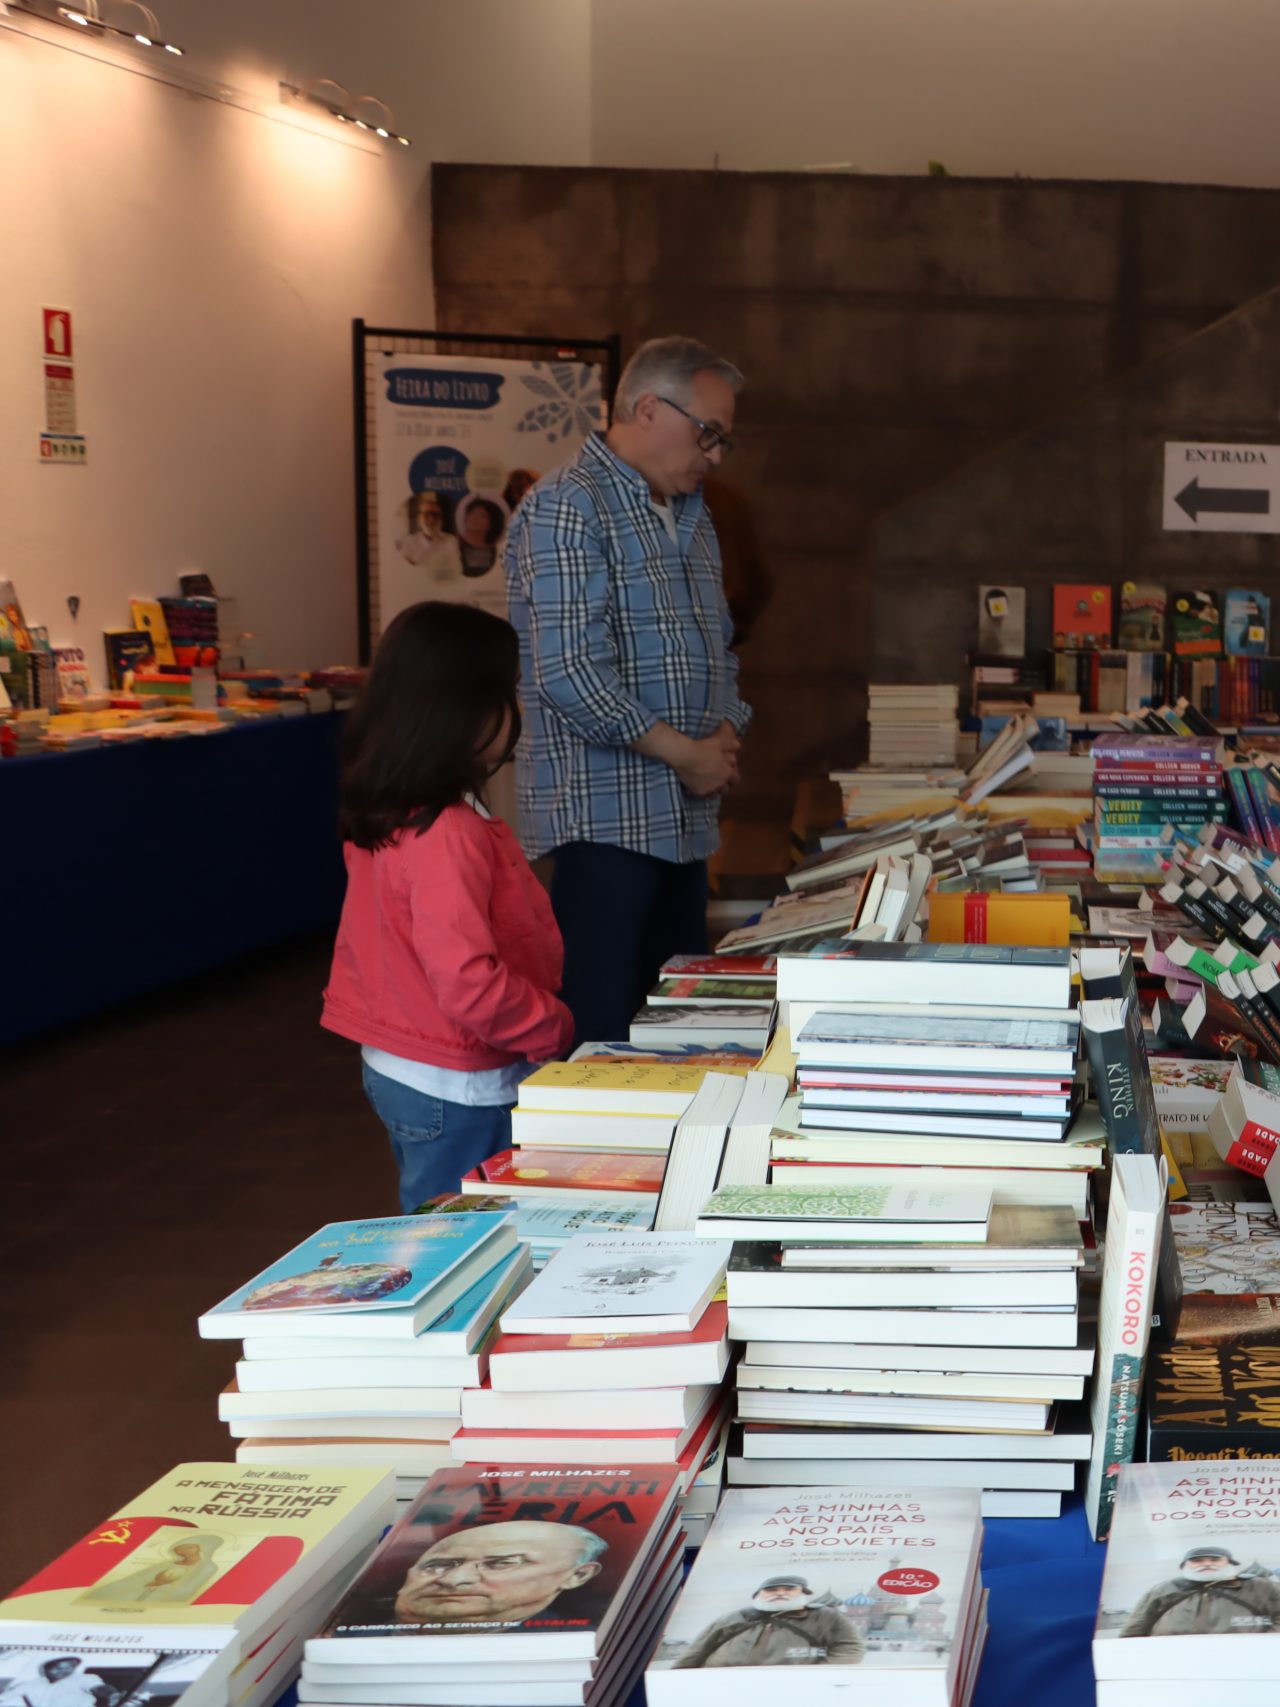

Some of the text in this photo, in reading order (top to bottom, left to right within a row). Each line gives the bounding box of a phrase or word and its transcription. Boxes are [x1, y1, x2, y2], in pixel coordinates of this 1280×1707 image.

[395, 376, 491, 402] FEIRA DO LIVRO
[1184, 448, 1268, 465] ENTRADA
[1152, 774, 1198, 782] COLLEEN HOOVER
[1153, 788, 1199, 797] COLLEEN HOOVER
[1107, 800, 1143, 812] VERITY
[1105, 812, 1140, 824] VERITY
[1107, 1062, 1136, 1119] STEPHEN KING
[1158, 1113, 1201, 1124] TRATO DE
[656, 1240, 718, 1248] PEIXOTO
[1121, 1251, 1147, 1346] KOKORO
[1116, 1364, 1131, 1418] NATSUME
[1152, 1346, 1236, 1428] A Idade
[242, 1468, 311, 1482] José Milhazes
[478, 1468, 632, 1479] JOSÉ MILHAZES
[1188, 1464, 1233, 1475] José
[176, 1479, 348, 1494] A MENSAGEM DE
[1175, 1477, 1211, 1487] AS
[430, 1480, 659, 1498] LAVRENTI
[210, 1489, 339, 1507] FÁTIMA
[793, 1491, 913, 1501] José Milhazes
[168, 1498, 313, 1519] NA RÚSSIA
[775, 1503, 922, 1514] AS MINHAS
[1196, 1498, 1236, 1508] NO
[410, 1501, 638, 1526] BERIA
[1151, 1510, 1207, 1523] DOS
[763, 1514, 927, 1526] AVENTURAS
[788, 1524, 895, 1536] NO PAÍS
[739, 1536, 937, 1550] DOS SOVIETES
[881, 1578, 935, 1590] EDIÇÃO
[349, 1623, 421, 1632] CARRASCO
[422, 1622, 443, 1630] AO
[444, 1621, 501, 1630] SERVIÇO
[503, 1620, 522, 1628] DE
[524, 1618, 592, 1628] ESTALINE
[50, 1633, 145, 1645] JOSÉ MILHAZES
